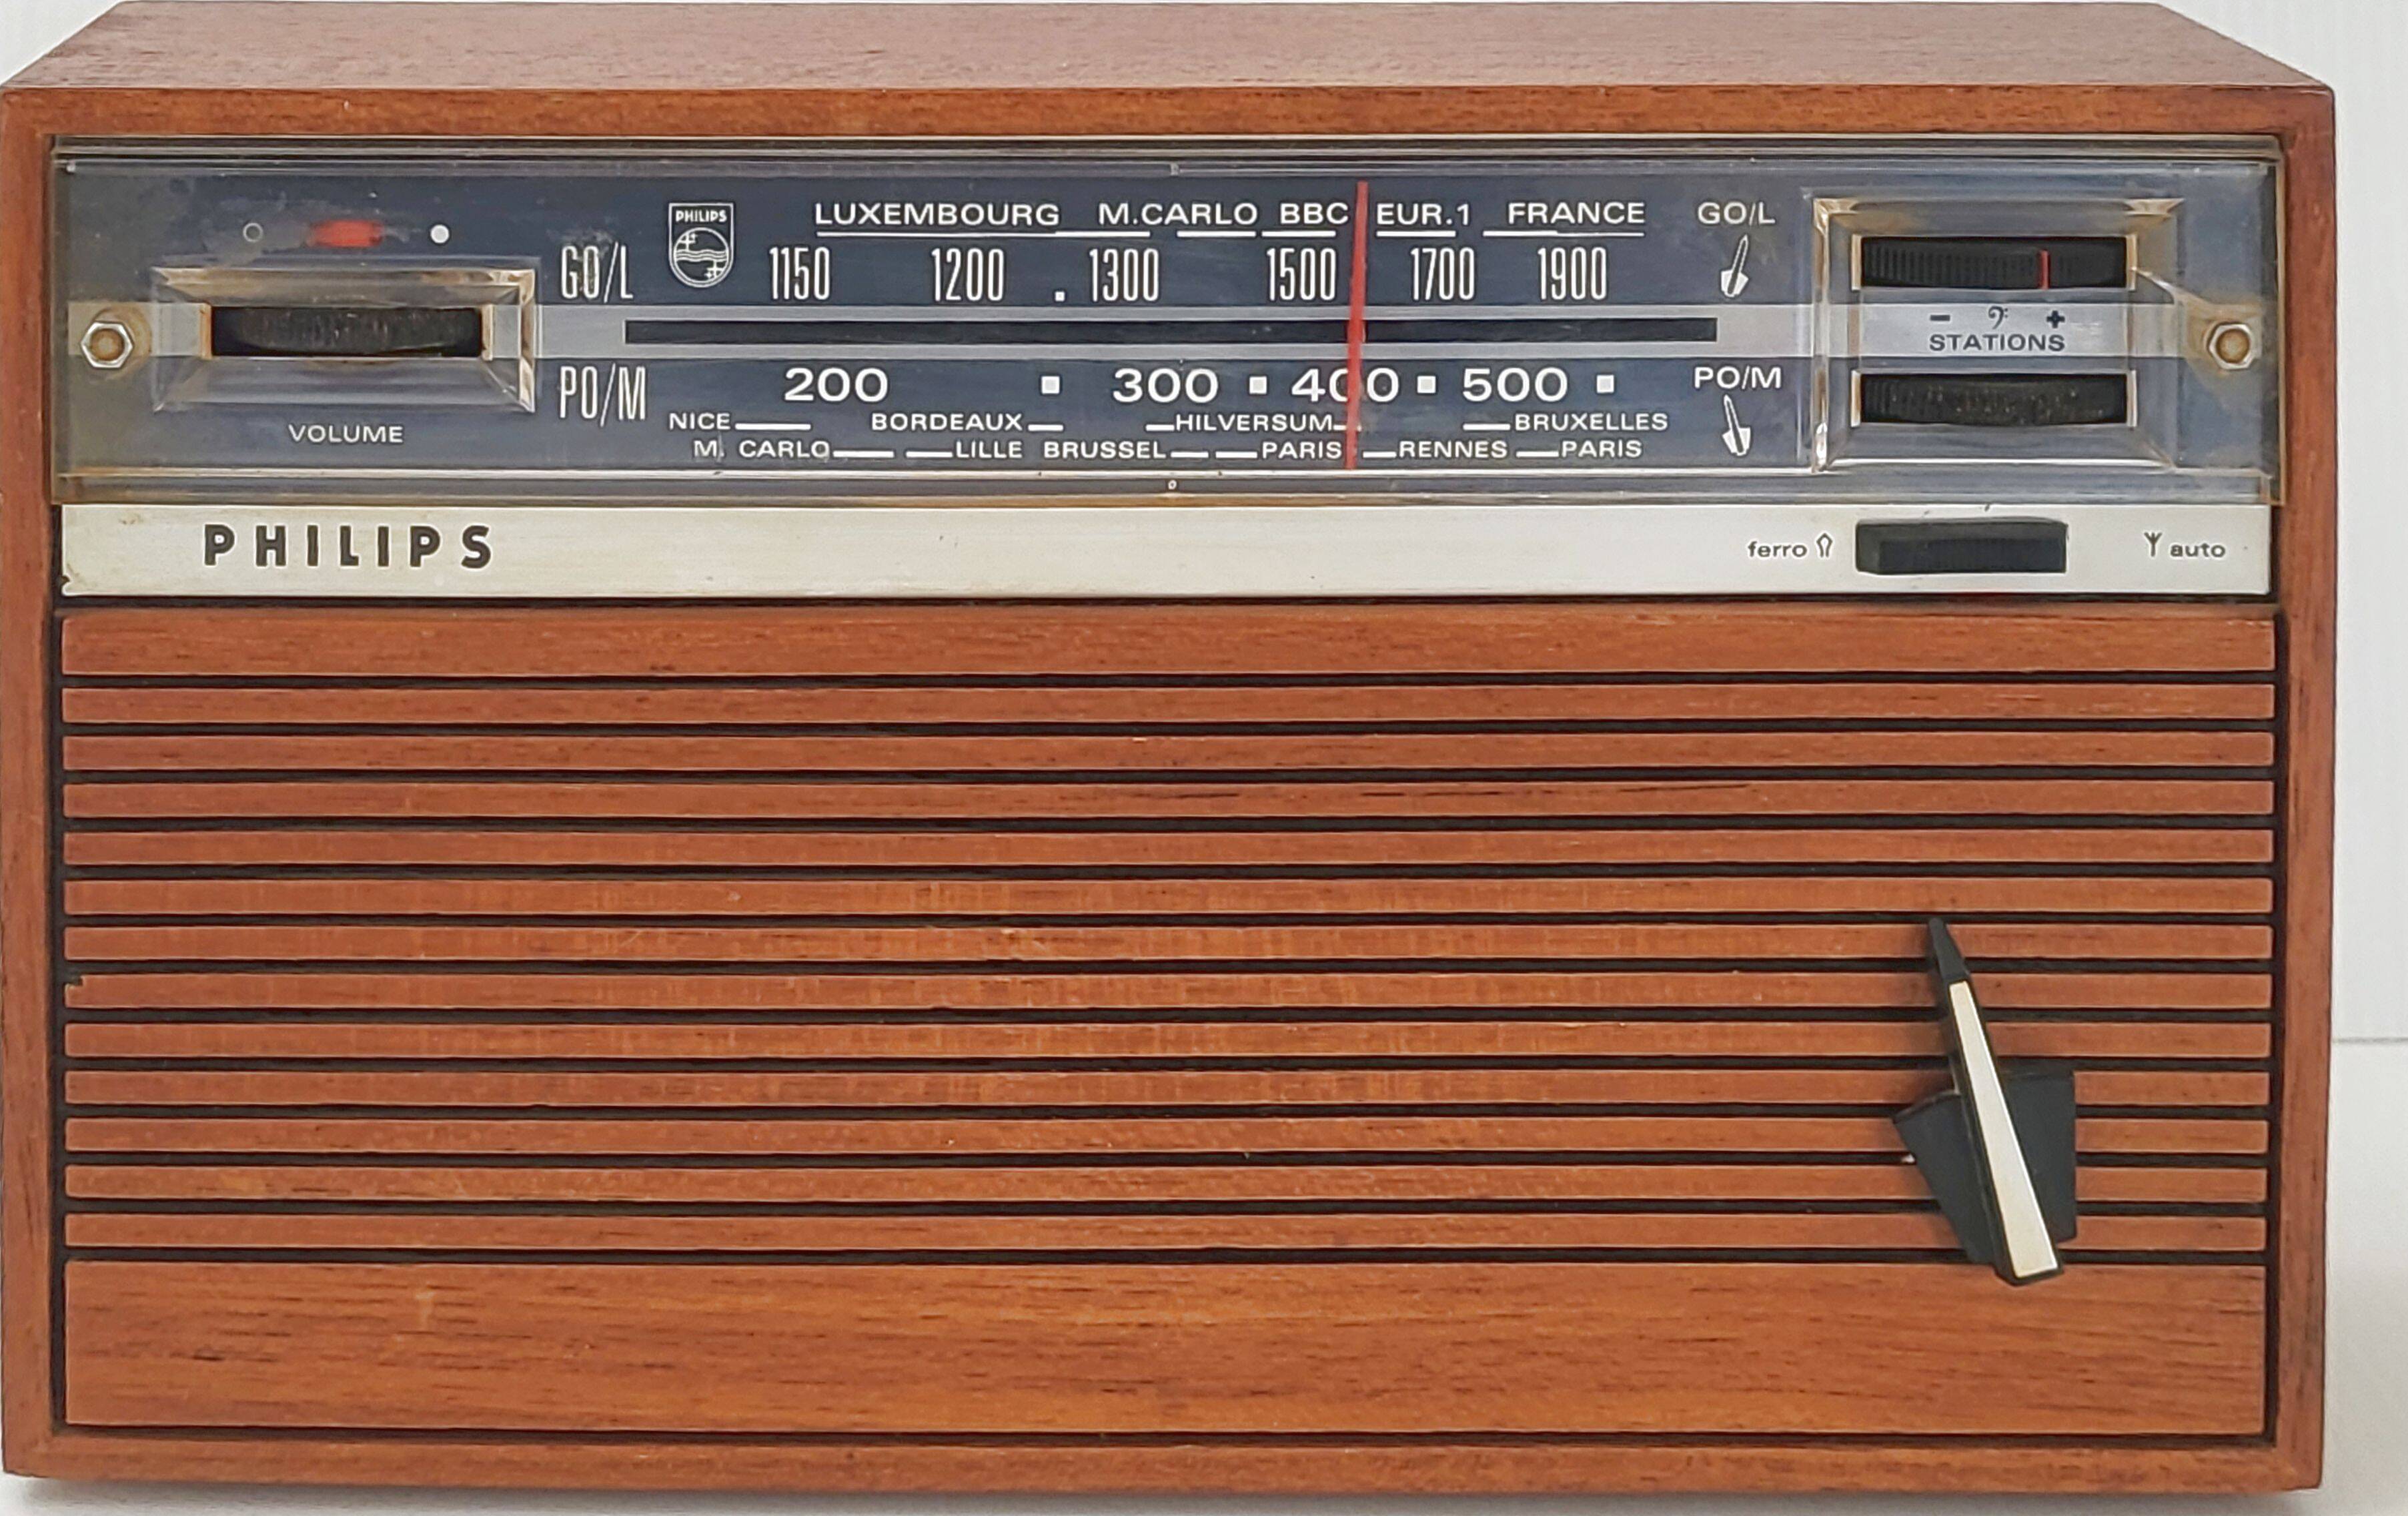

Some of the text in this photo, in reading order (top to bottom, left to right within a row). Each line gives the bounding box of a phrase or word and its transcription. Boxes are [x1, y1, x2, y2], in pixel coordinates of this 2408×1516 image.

[675, 209, 728, 224] PHILIPS
[815, 202, 1646, 226] LUXEMBOURG M.CARLO BBC EUR.1 FRANCE
[1696, 202, 1776, 226] GO/L
[560, 242, 1608, 303] GO/L 1150 1200 1300 1500 1700 1900
[1929, 333, 2066, 353] STATIONS
[1694, 367, 1782, 392] PO/M
[559, 363, 646, 427] PO/M
[784, 368, 888, 402] 200
[1113, 368, 1219, 402] 300
[1462, 368, 1568, 402] 500
[669, 412, 1668, 432] NICE BORDEAUX HILVERSUM BRUXELLES
[288, 424, 404, 444] VOLUME
[738, 440, 830, 459] CARLO
[956, 441, 1023, 459] LILLE
[1044, 441, 1167, 459] BRUSSEL
[1262, 441, 1342, 459] PARIS
[1399, 440, 1508, 458] RENNES
[1562, 440, 1642, 458] PARIS
[203, 524, 492, 568] PHILIPS
[1748, 540, 1808, 559] ferro
[2170, 541, 2226, 559] auto
